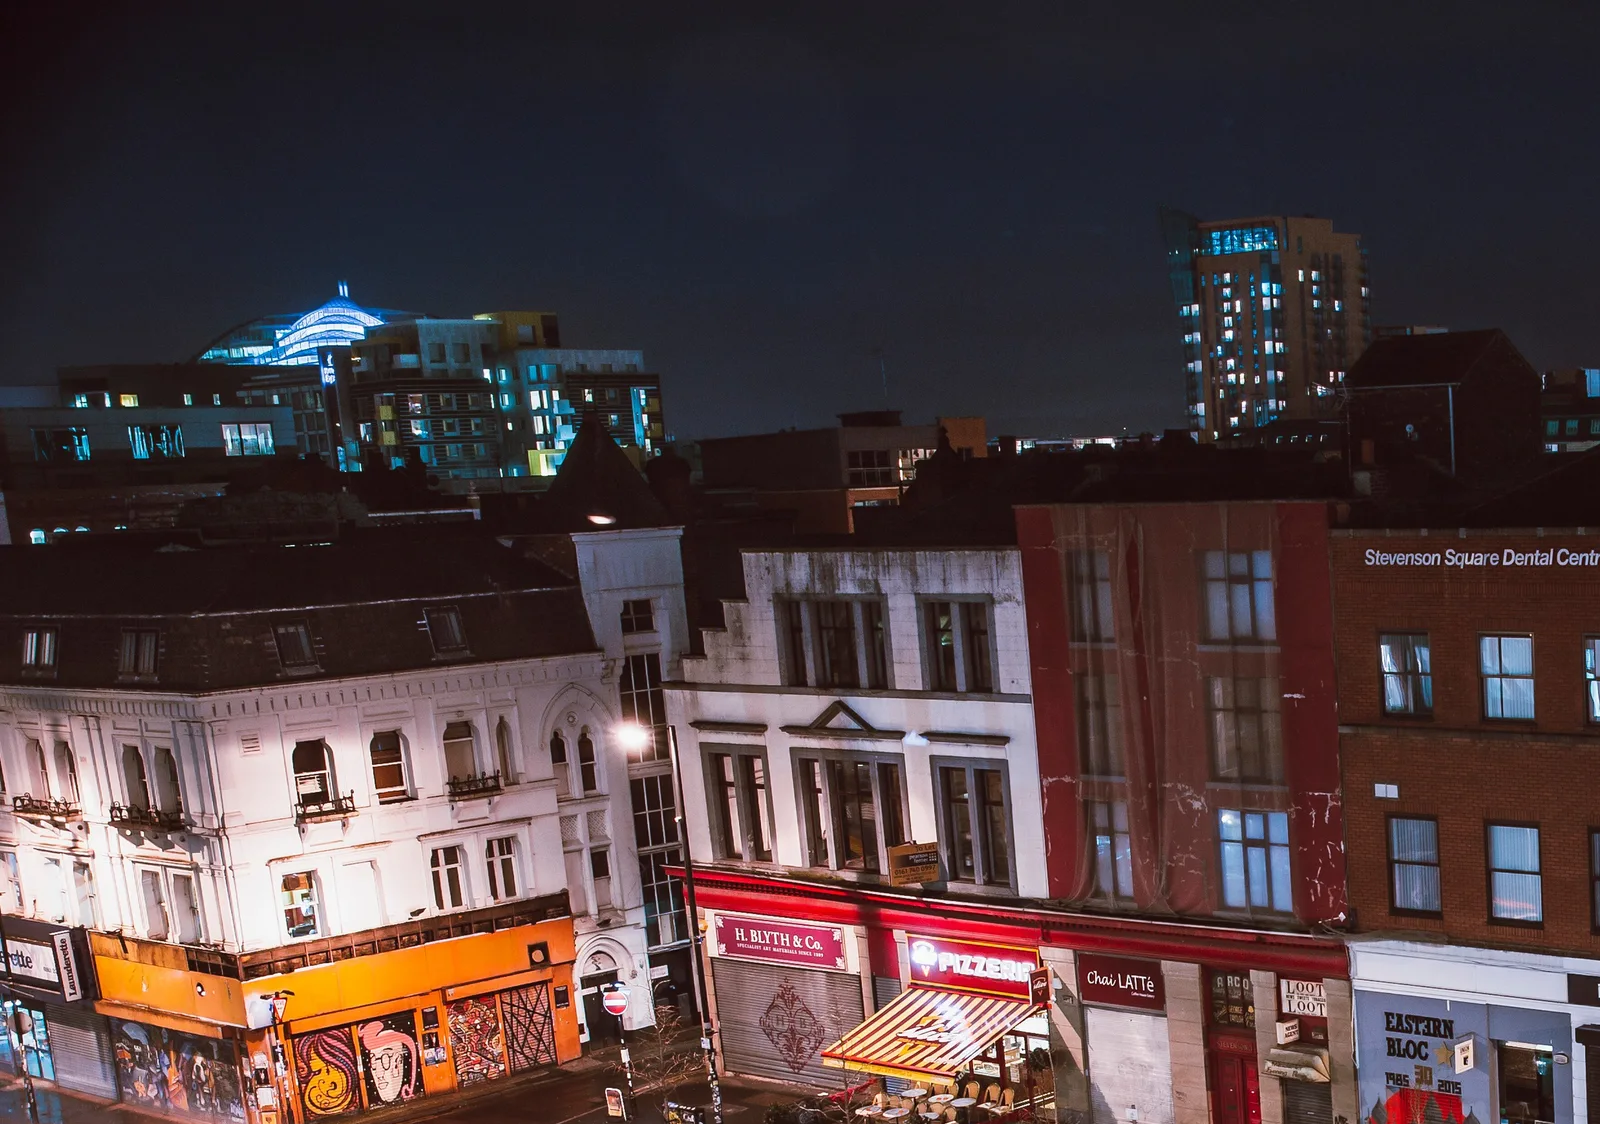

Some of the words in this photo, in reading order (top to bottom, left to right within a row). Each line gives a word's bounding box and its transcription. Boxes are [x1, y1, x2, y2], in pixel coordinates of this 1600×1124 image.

[1364, 549, 1441, 566] Stevenson
[1444, 549, 1500, 570] Square
[1502, 549, 1554, 566] Dental
[735, 927, 748, 941] H.
[750, 929, 790, 947] BLYTH
[793, 935, 803, 948] &
[805, 935, 823, 951] Co.
[60, 938, 78, 997] Launderette
[1087, 970, 1117, 987] Chai
[1117, 973, 1154, 992] LATTé
[1286, 981, 1324, 997] LOOT
[1288, 1000, 1326, 1016] LOOT
[1386, 1037, 1429, 1061] BLOC
[1385, 1072, 1409, 1087] 1985
[1437, 1079, 1462, 1094] 2015
